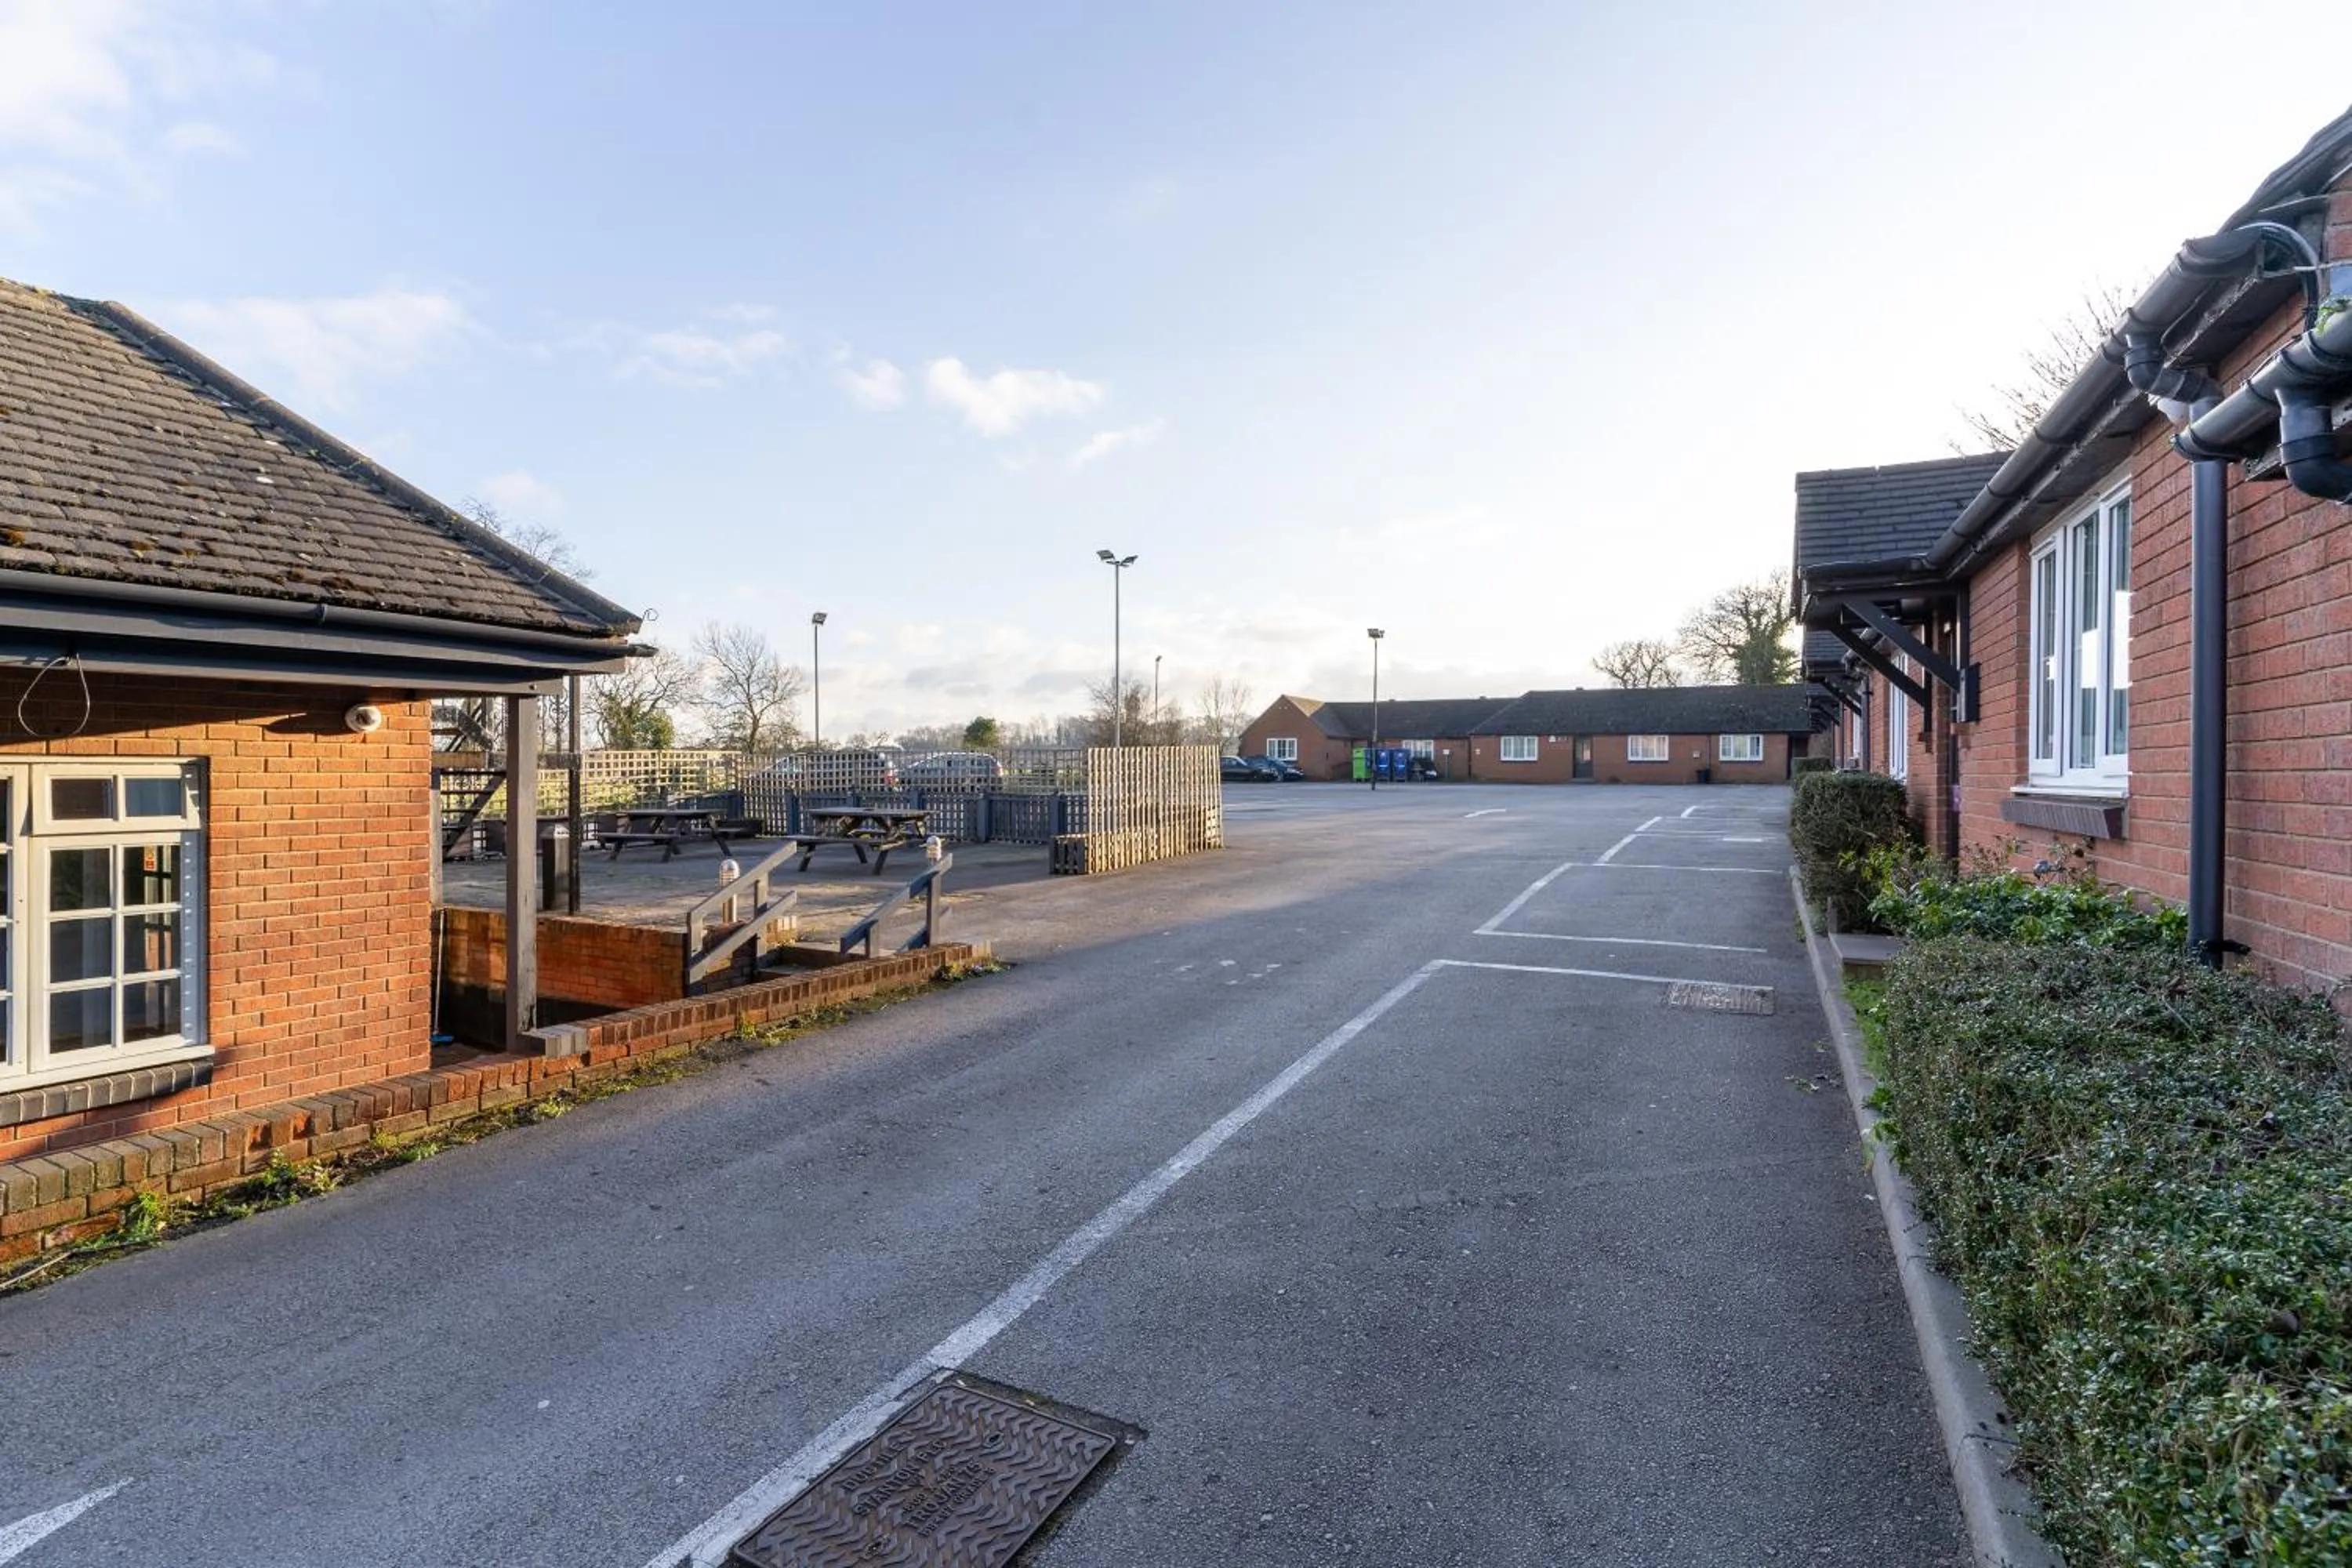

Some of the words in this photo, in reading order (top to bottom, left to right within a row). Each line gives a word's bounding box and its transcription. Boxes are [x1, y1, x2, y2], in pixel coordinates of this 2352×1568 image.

[852, 1461, 920, 1515] STANTON
[915, 1440, 947, 1463] PLC
[904, 1475, 966, 1530] TROJAN
